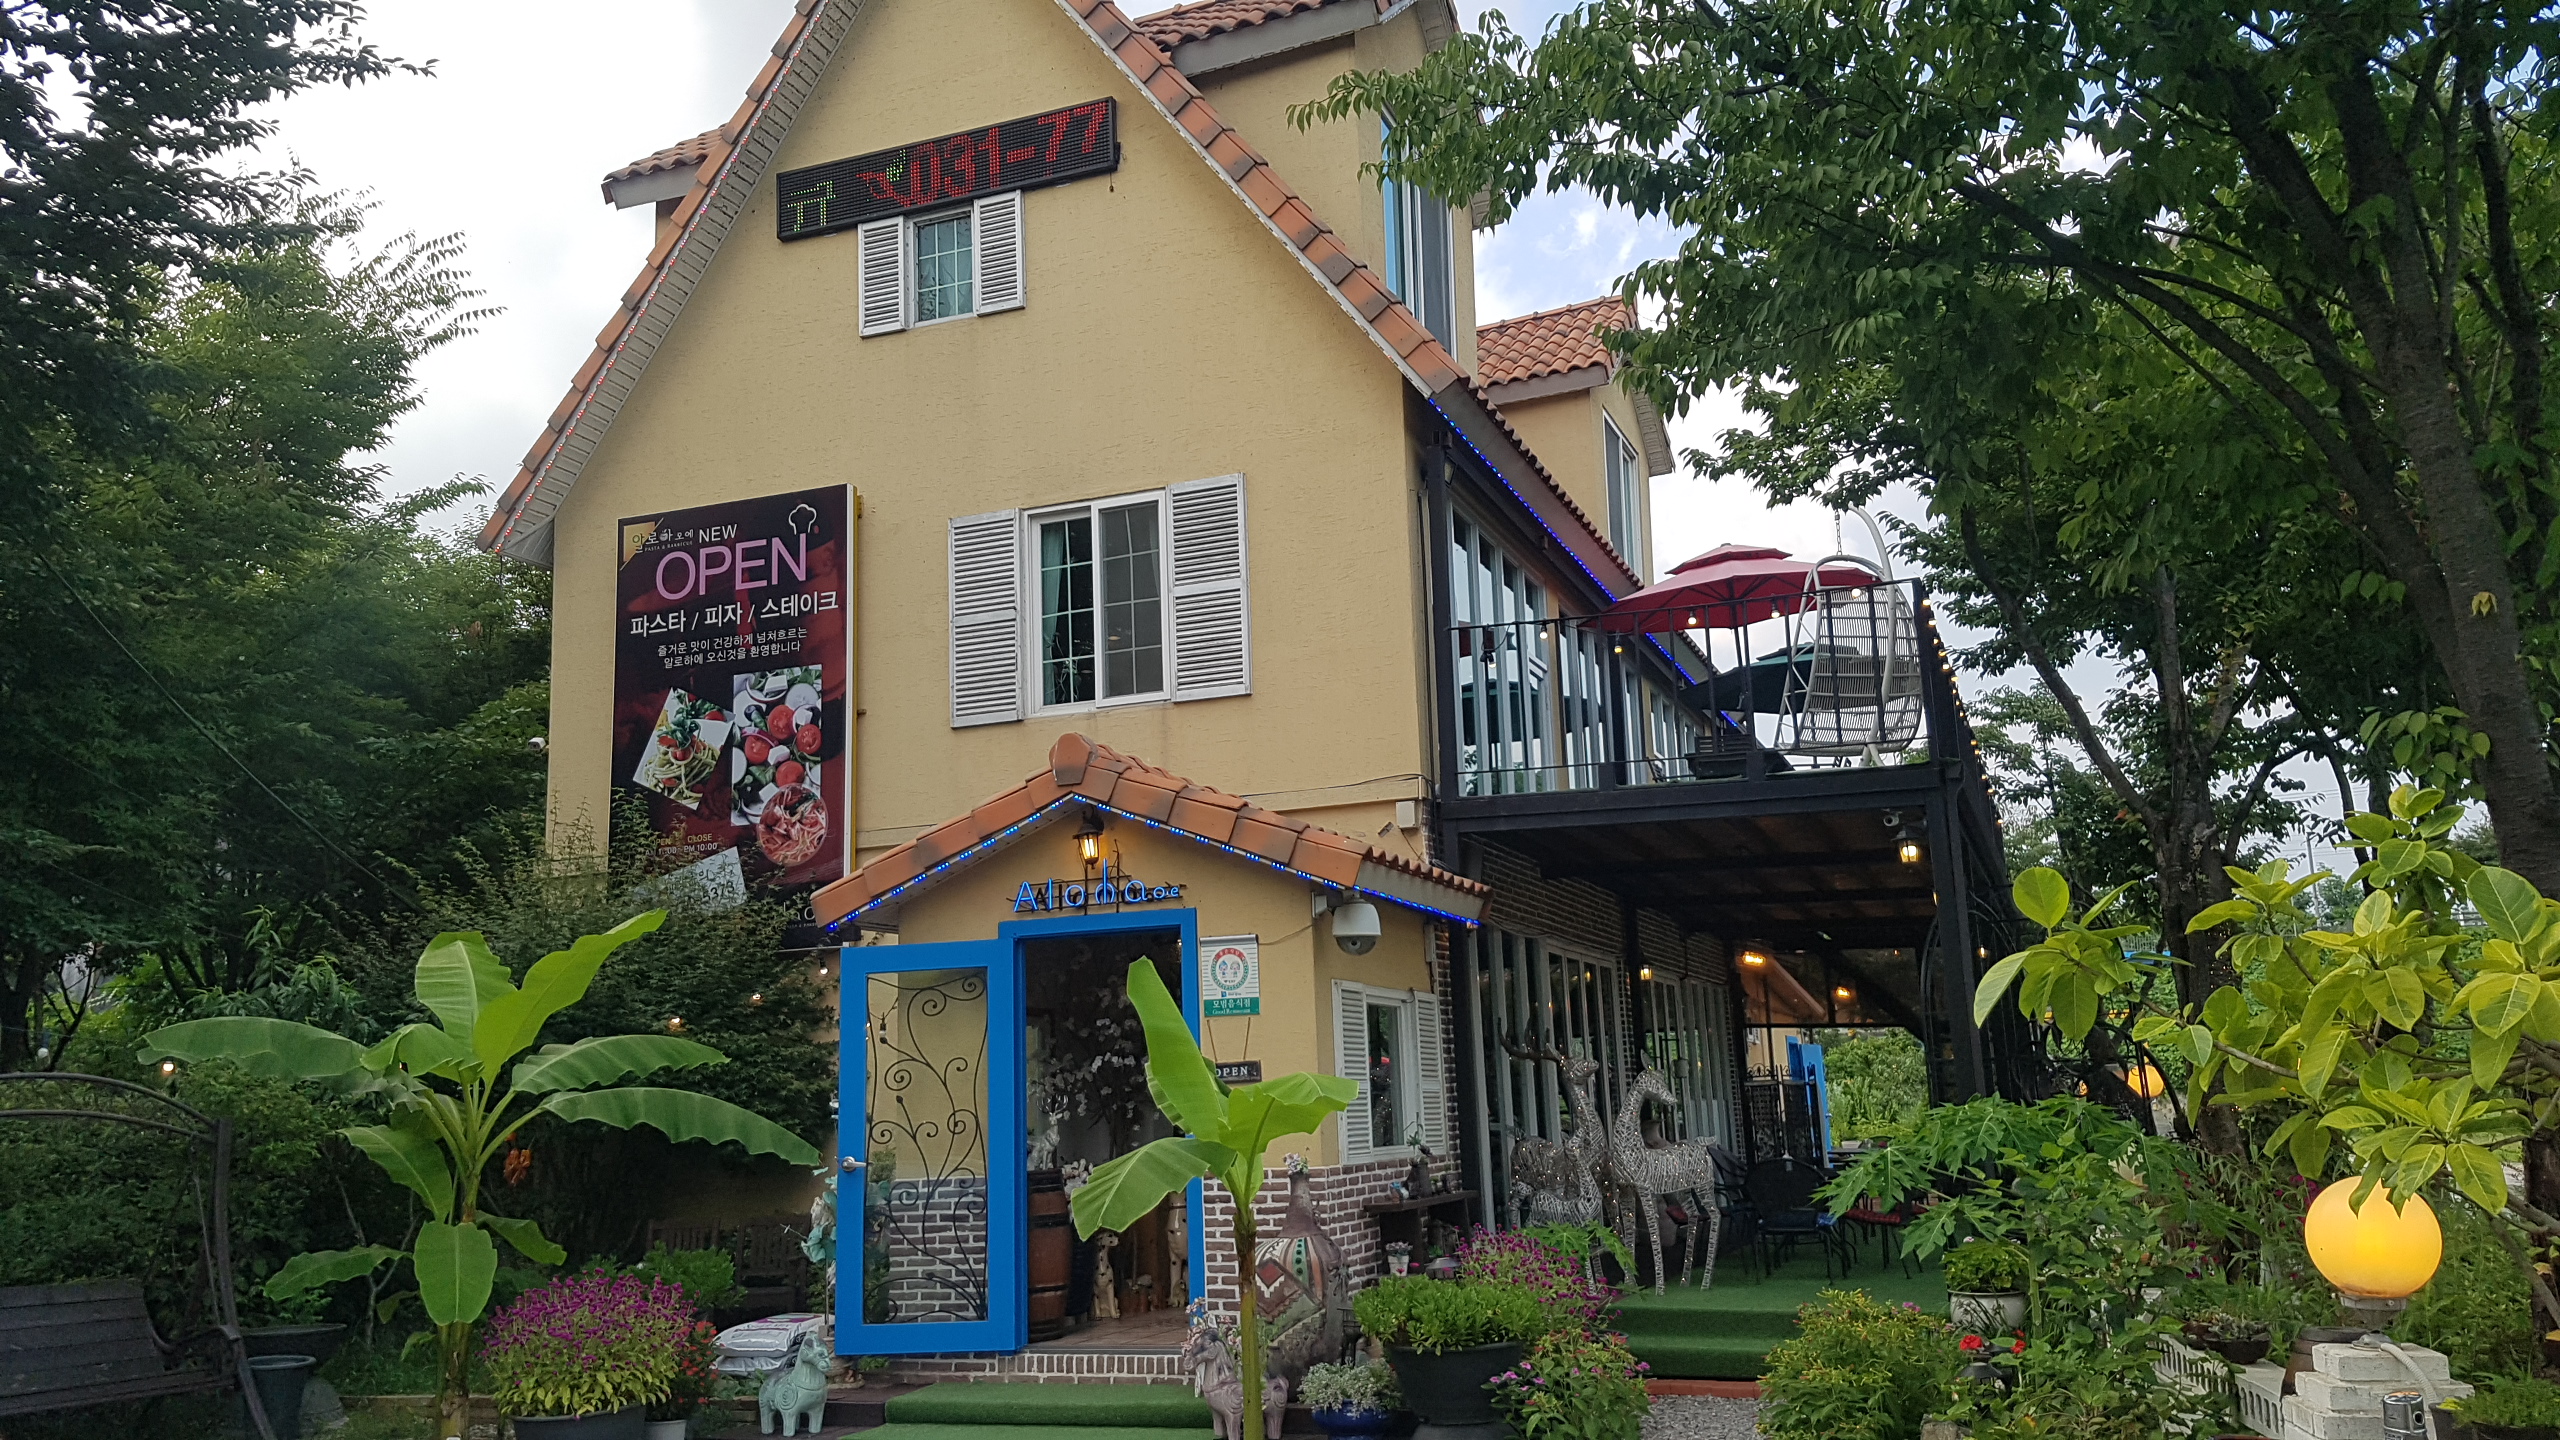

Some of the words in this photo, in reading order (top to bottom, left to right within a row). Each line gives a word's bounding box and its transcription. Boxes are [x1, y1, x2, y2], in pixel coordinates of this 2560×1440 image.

[910, 101, 1107, 206] 031-77
[699, 524, 737, 544] NEW
[655, 533, 807, 600] OPEN
[630, 609, 686, 637] 파스타
[704, 601, 743, 627] 피자
[760, 590, 839, 619] 스테이크
[658, 641, 687, 657] 즐거운
[690, 638, 710, 653] 맛이
[713, 633, 753, 649] 건강하게
[756, 627, 808, 643] 넘쳐흐르는
[706, 647, 747, 663] 오신것을
[750, 640, 800, 658] 환영합니다
[684, 844, 695, 853] PM
[697, 842, 718, 852] 10:00
[687, 833, 713, 843] CLOSE
[1212, 998, 1251, 1009] 모범음식점
[1215, 1065, 1249, 1077] OPEN
